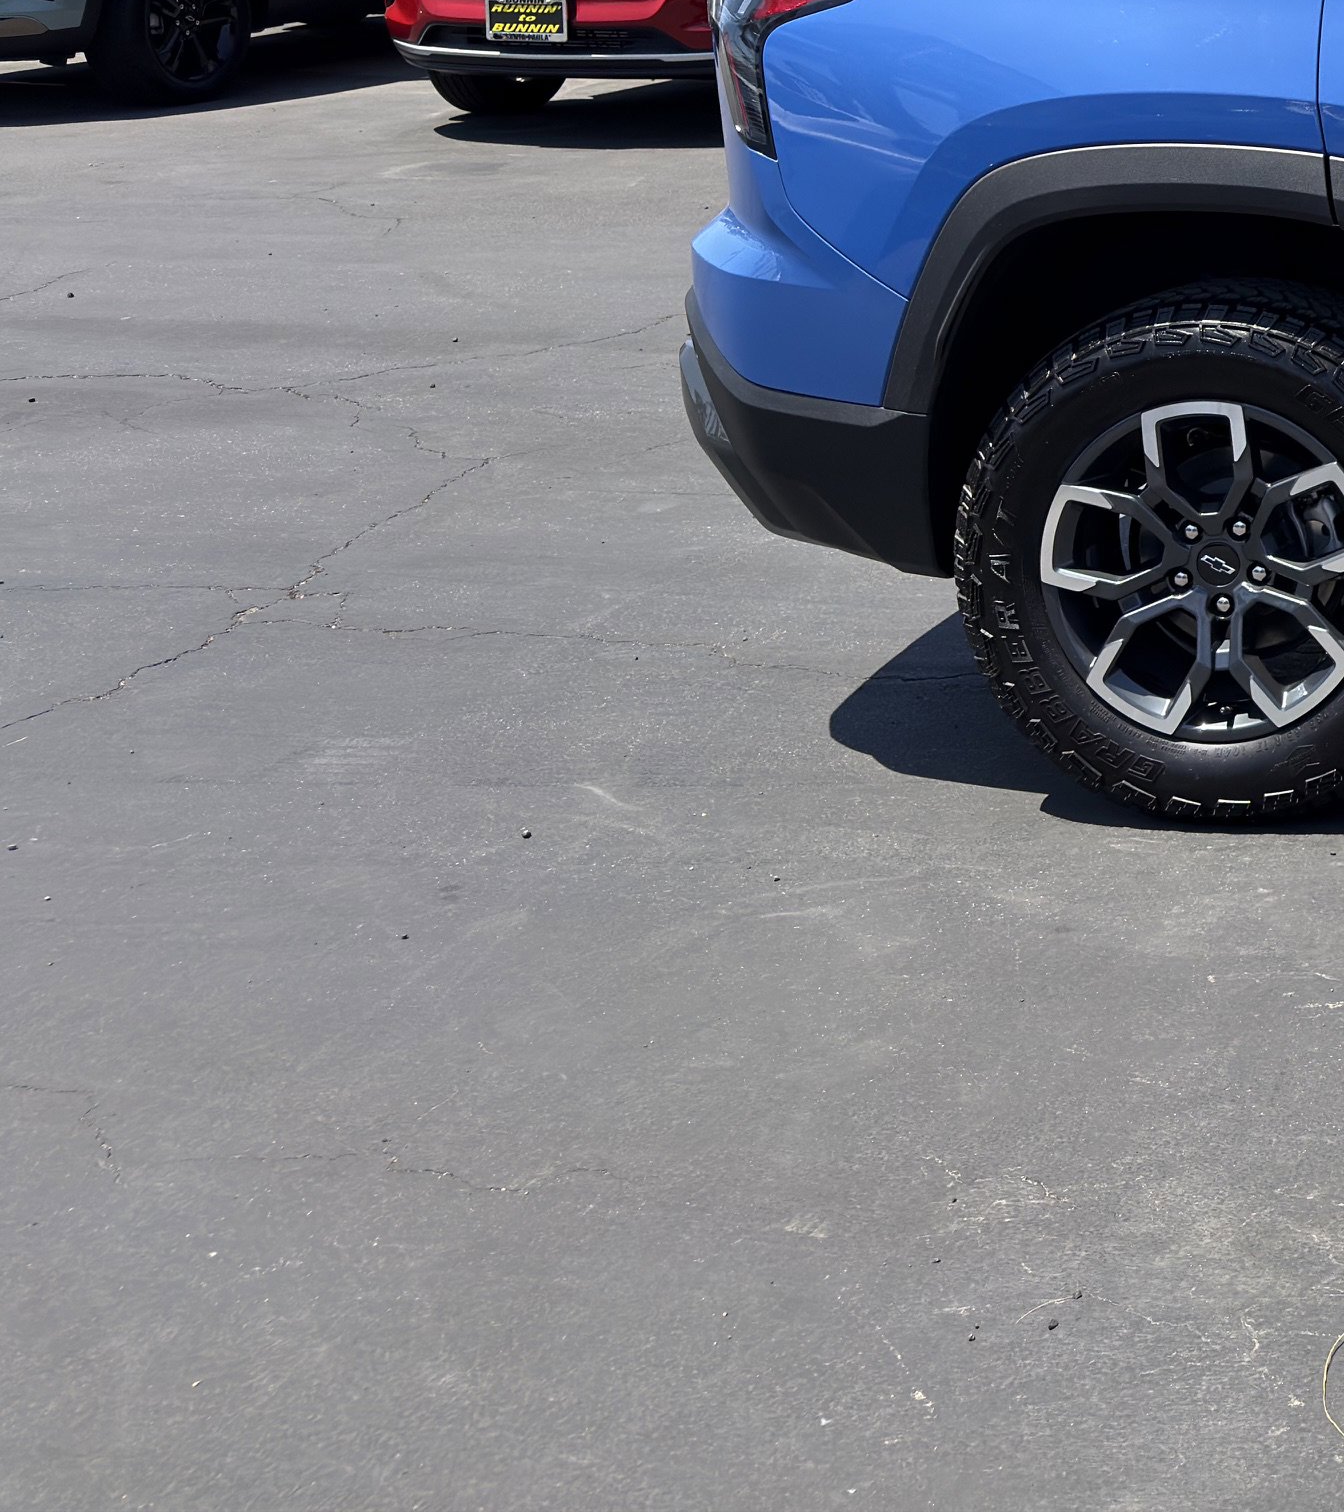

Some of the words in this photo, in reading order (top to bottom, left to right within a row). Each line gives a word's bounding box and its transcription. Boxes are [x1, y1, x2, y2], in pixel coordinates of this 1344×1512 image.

[490, 4, 562, 14] RUNNIN'
[518, 14, 536, 22] to
[491, 23, 560, 33] BUNNIN
[993, 599, 1166, 783] GRABBER
